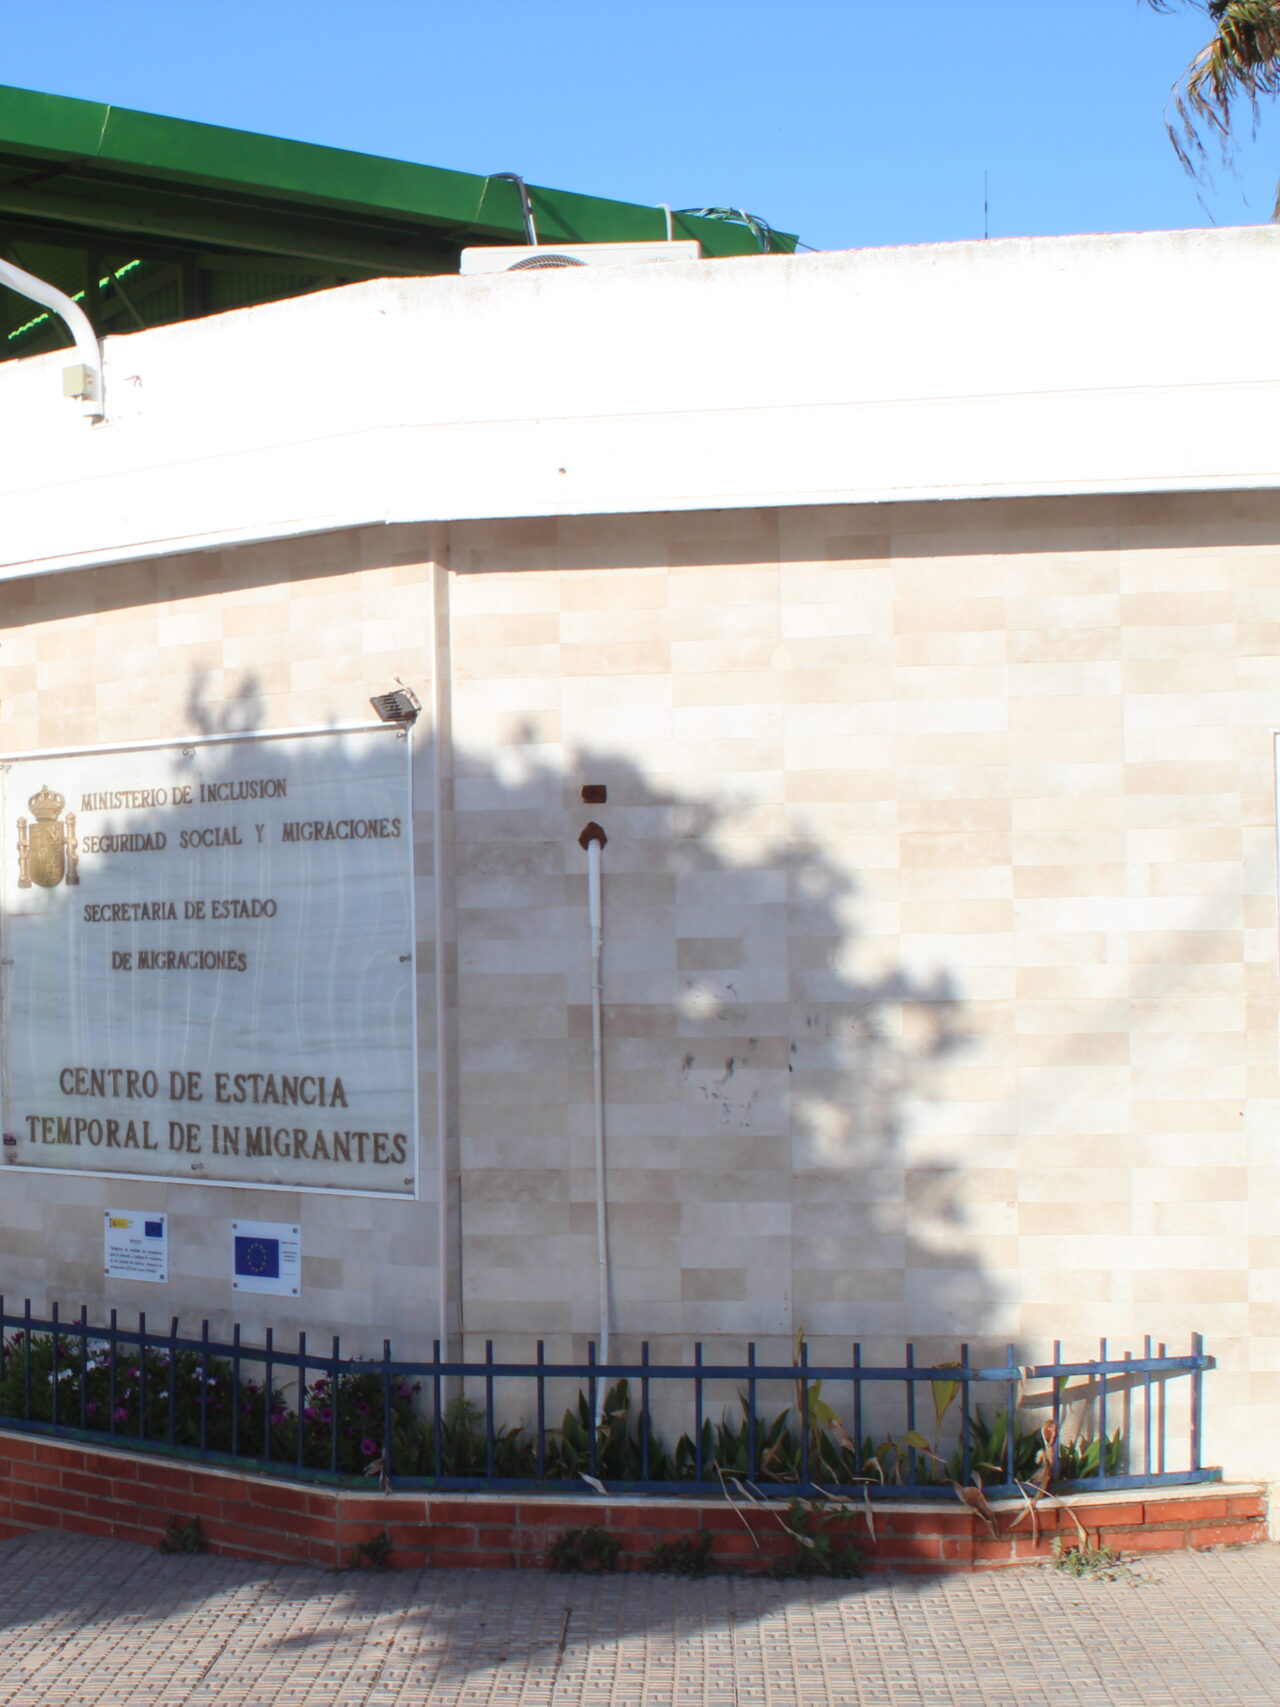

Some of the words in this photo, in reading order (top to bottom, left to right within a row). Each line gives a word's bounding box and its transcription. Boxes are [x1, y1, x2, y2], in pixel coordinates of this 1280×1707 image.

[80, 787, 167, 812] MINISTERIO
[172, 784, 194, 806] DE
[199, 778, 288, 802] INCLUSION
[81, 831, 167, 854] SEGURIDAD
[179, 826, 243, 849] SOCIAL
[255, 823, 265, 844] Y
[282, 817, 402, 843] MIGRACIONES
[83, 901, 177, 923] SECRETARIA
[184, 899, 206, 920] DE
[211, 898, 278, 919] ESTADO
[111, 951, 133, 972] DE
[137, 950, 248, 973] MIGRACIONES
[59, 1067, 159, 1099] CENTRO
[169, 1070, 204, 1102] DE
[214, 1072, 349, 1108] ESTANCIA
[25, 1115, 158, 1151] TEMPORAL
[169, 1121, 202, 1154] DE
[212, 1124, 408, 1165] INMIGRANTES
